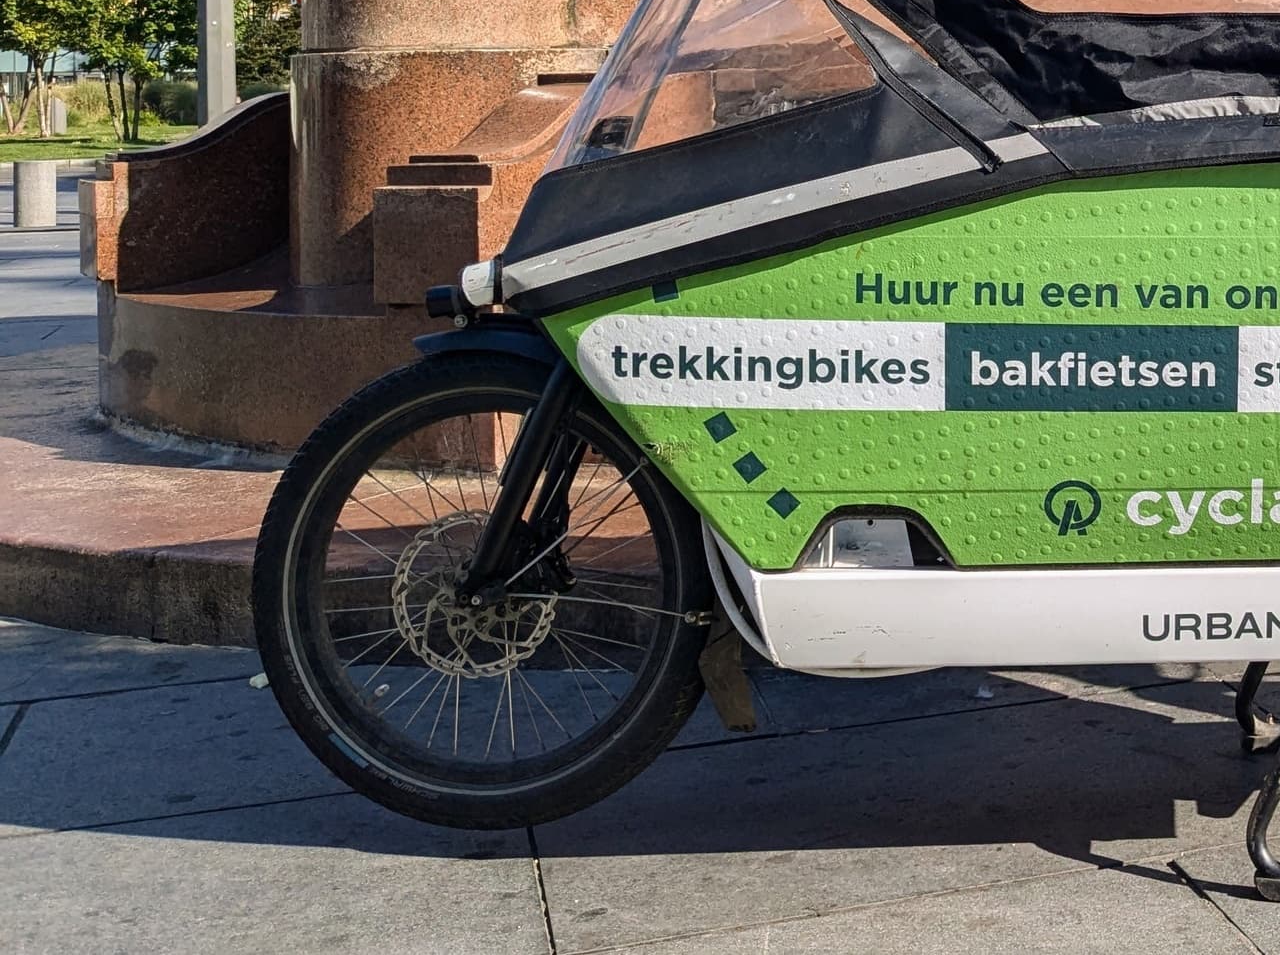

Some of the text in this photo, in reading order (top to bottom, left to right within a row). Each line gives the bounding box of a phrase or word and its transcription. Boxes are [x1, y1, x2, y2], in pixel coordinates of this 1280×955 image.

[855, 273, 957, 305] Huur
[974, 282, 1025, 307] nu
[1040, 283, 1119, 309] een
[1135, 284, 1209, 309] van
[611, 345, 931, 390] trekkingbikes
[971, 351, 1216, 388] bakfietsen
